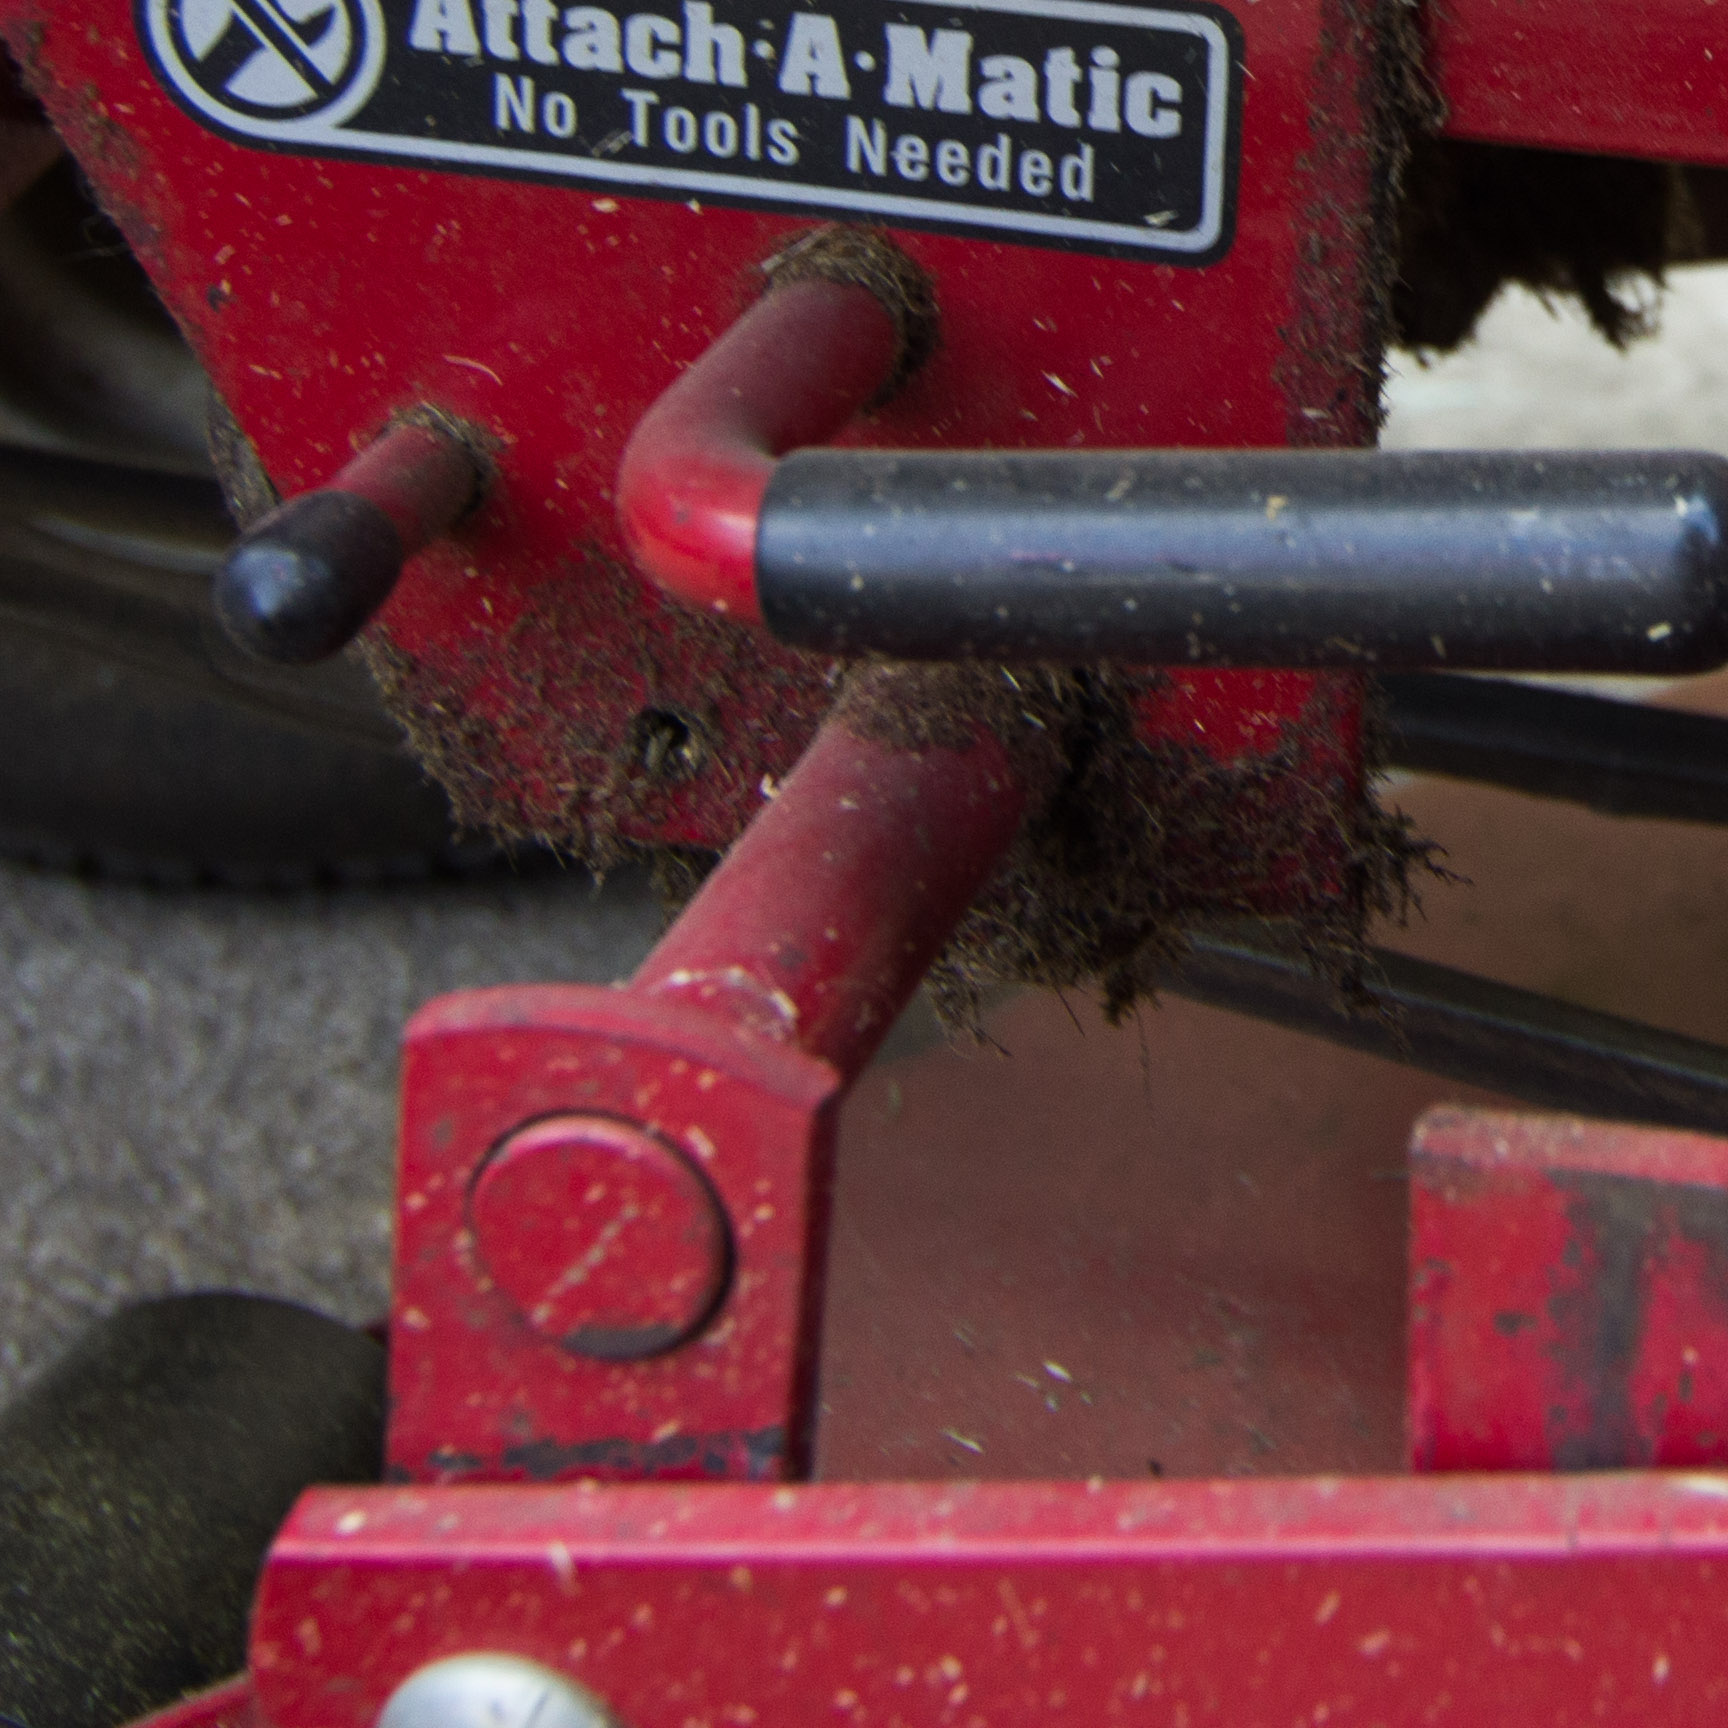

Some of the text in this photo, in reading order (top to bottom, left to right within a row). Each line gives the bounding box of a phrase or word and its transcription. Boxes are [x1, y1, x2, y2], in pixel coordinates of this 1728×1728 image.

[495, 72, 1095, 202] No Tools Needed
